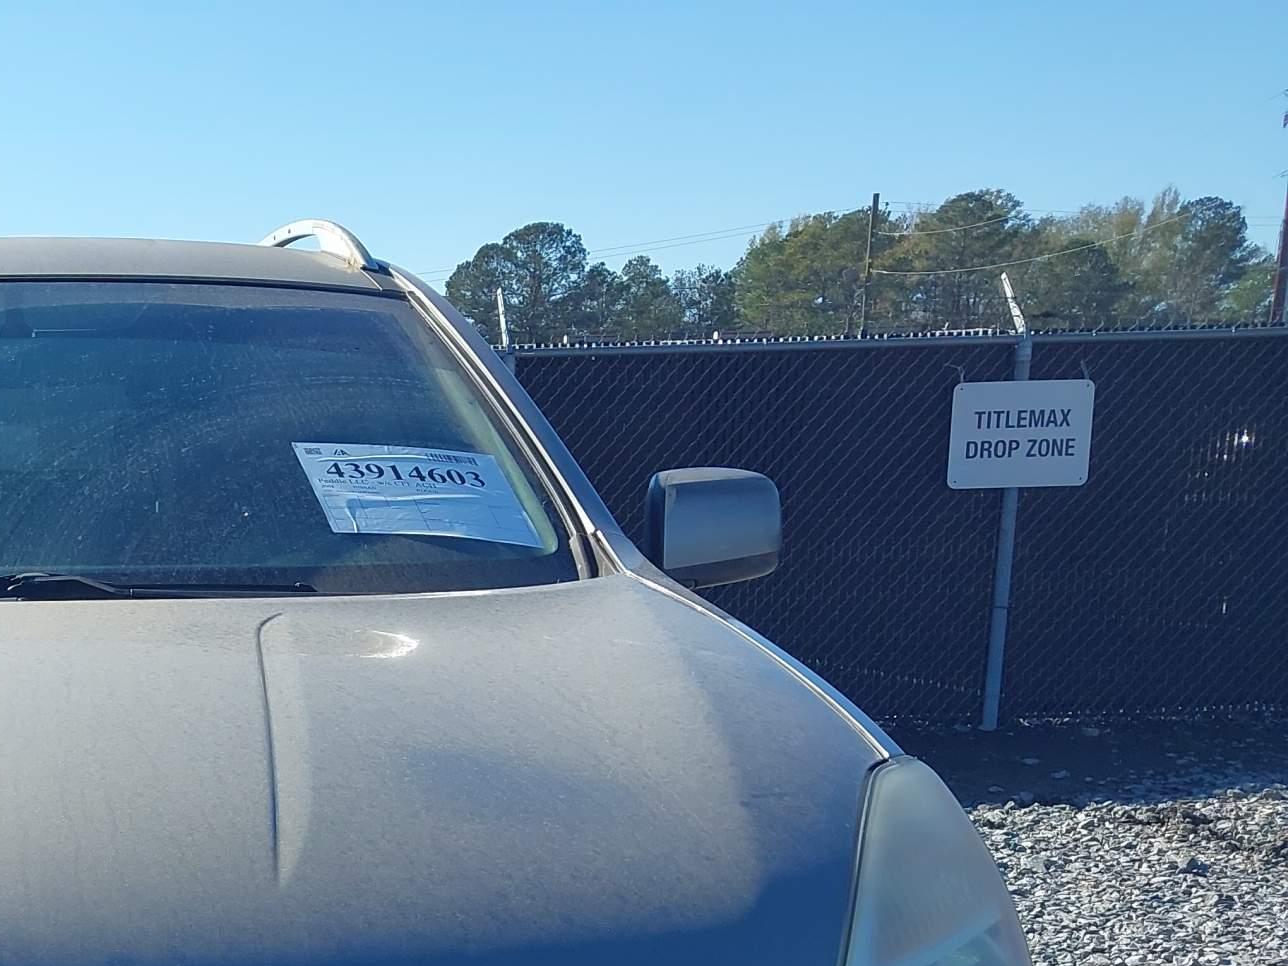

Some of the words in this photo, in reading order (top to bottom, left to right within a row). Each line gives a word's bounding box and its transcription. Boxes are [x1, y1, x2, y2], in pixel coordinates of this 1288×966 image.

[974, 409, 1072, 429] TITLEMAX
[965, 439, 1020, 459] DROP
[1025, 438, 1076, 458] ZONE
[326, 462, 486, 488] 43914603
